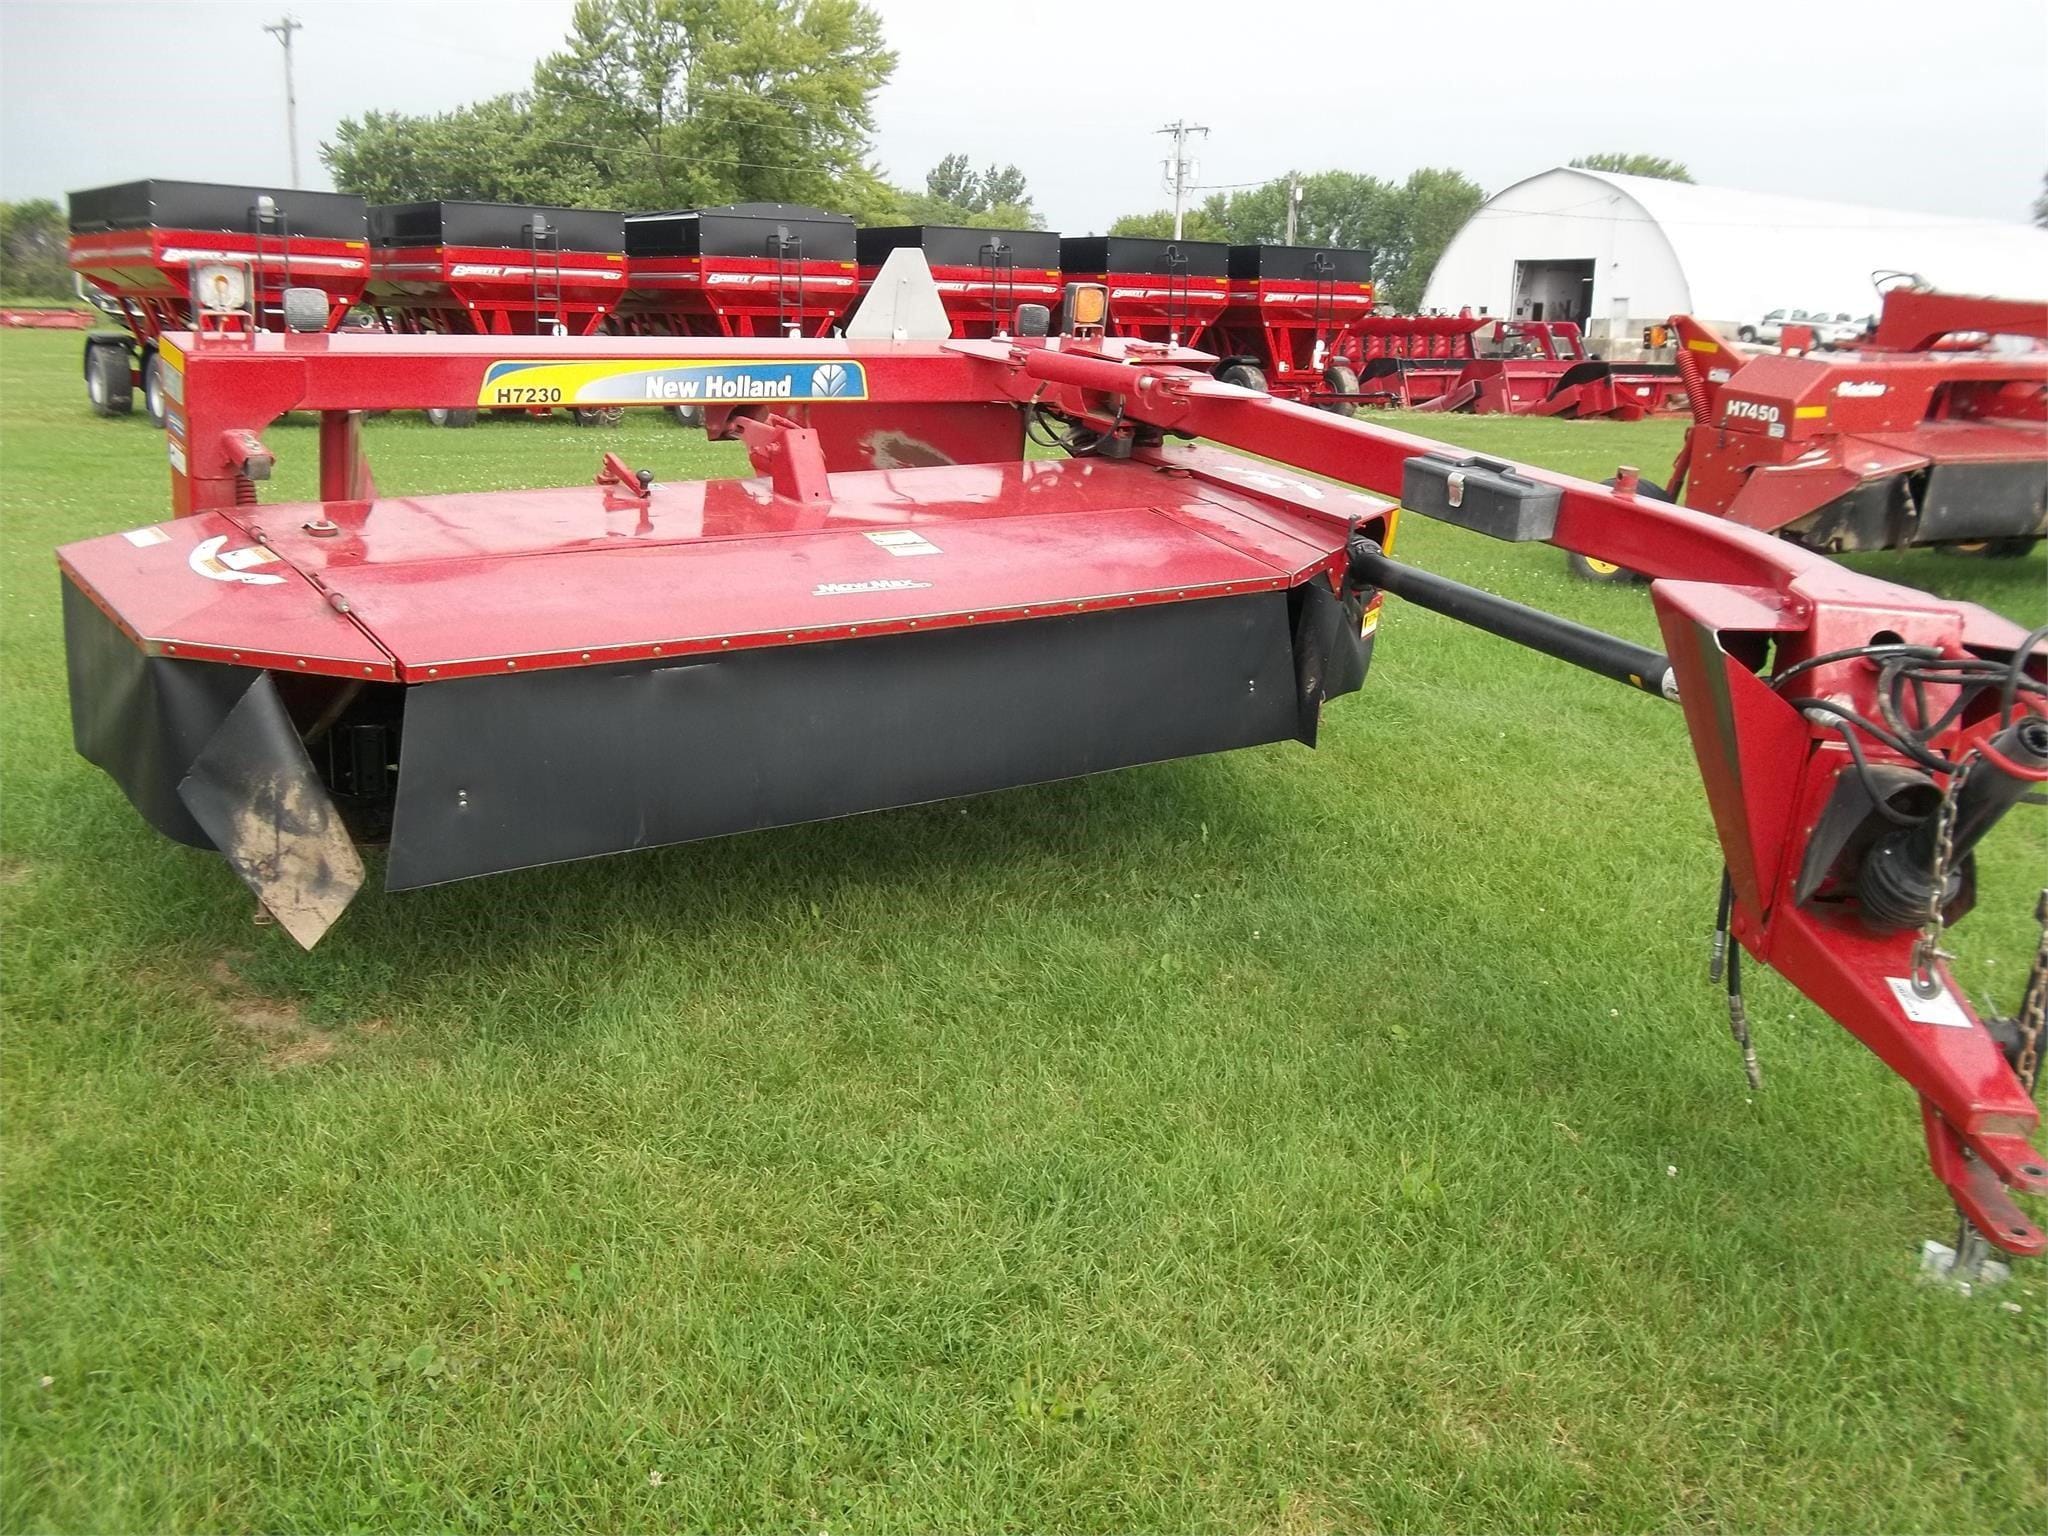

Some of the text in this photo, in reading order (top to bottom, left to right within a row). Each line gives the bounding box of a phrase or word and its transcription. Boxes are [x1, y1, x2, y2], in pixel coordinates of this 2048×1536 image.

[497, 388, 562, 403] H7230
[646, 375, 792, 398] New Holland
[1727, 400, 1779, 423] H7450
